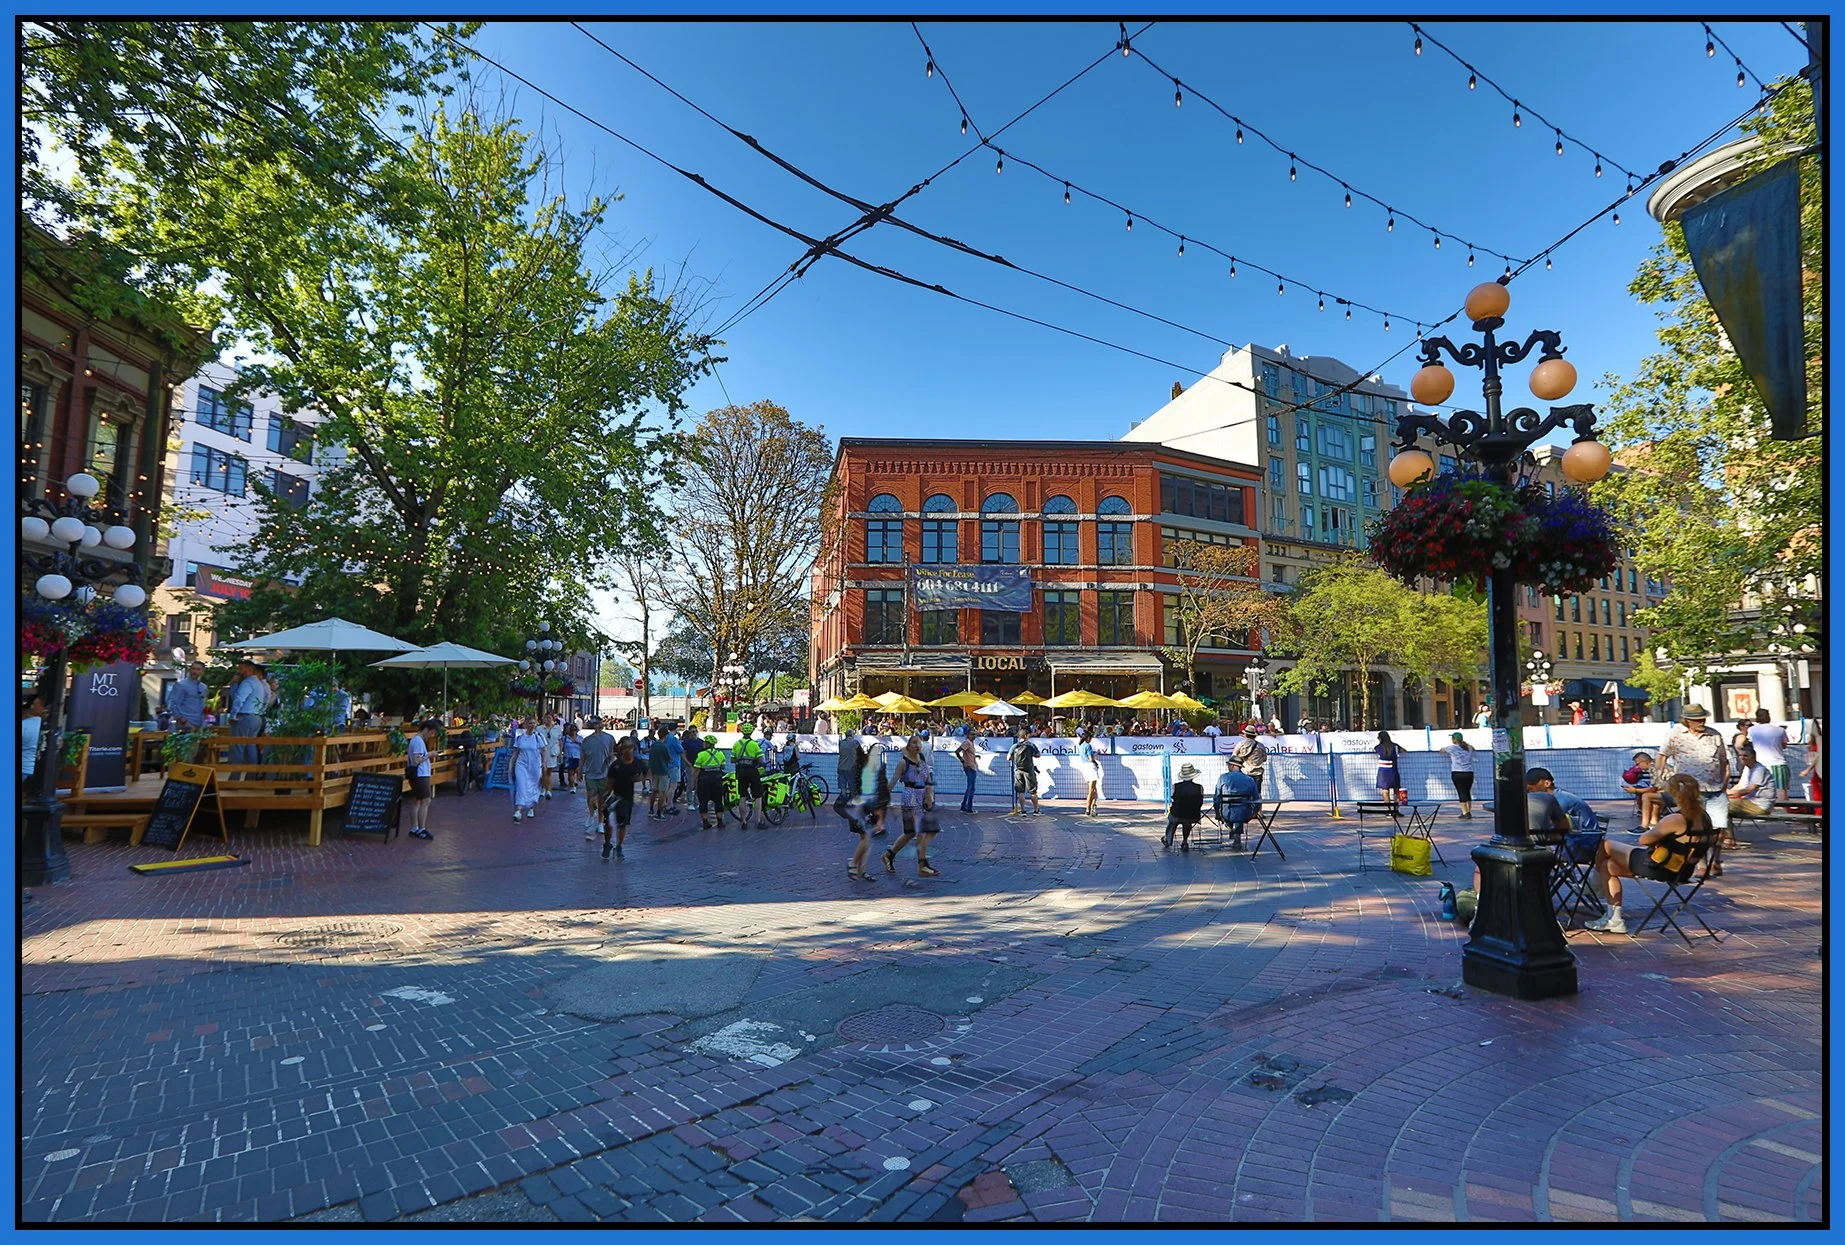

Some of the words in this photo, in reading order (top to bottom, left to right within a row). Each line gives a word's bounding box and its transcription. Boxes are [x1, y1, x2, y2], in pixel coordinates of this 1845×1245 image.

[916, 578, 943, 591] 604
[945, 580, 968, 592] 681
[971, 581, 998, 593] 4111
[978, 656, 1027, 670] LOCAL
[93, 672, 118, 687] MT
[1132, 743, 1165, 752] gastown
